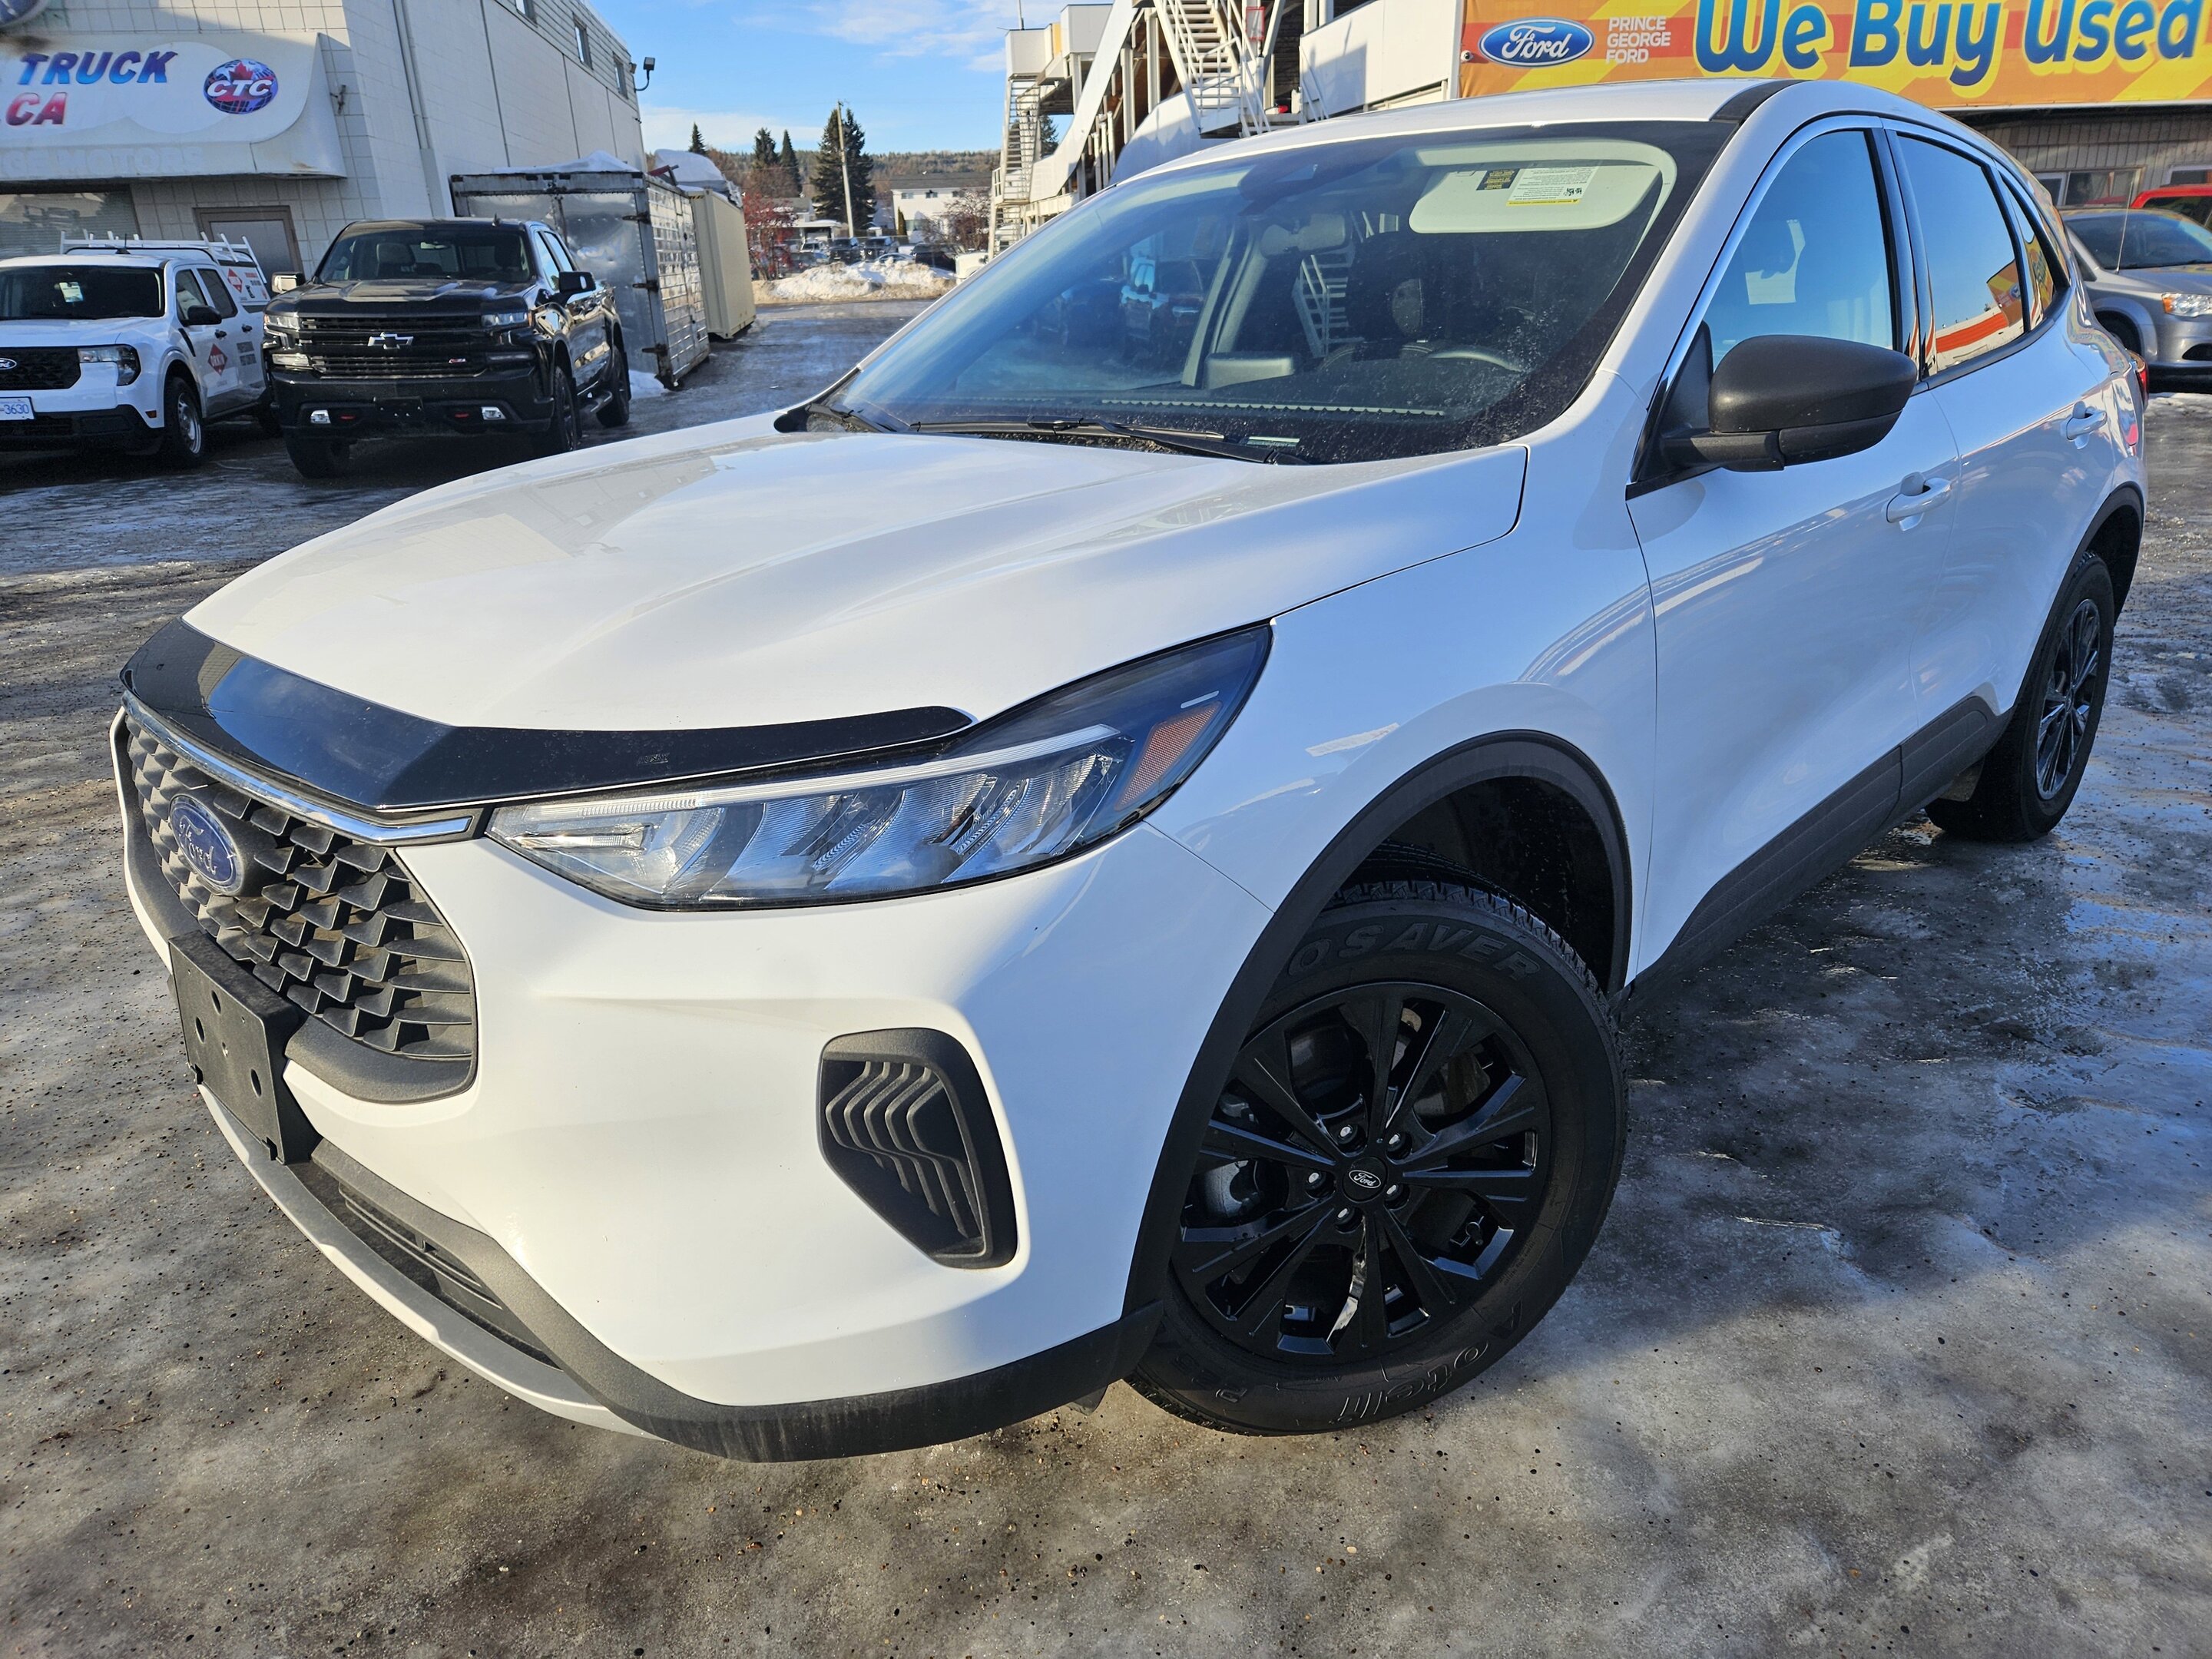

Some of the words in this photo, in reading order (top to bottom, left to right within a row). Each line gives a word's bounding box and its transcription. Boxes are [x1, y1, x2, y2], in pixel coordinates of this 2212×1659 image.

[1608, 17, 1667, 31] PRINCE
[1502, 25, 1572, 58] Ford
[1607, 32, 1671, 48] GEORGE
[1695, 0, 1826, 72] We
[1849, 0, 2001, 86] Buy
[17, 51, 178, 85] TRUCK
[1605, 48, 1649, 64] FORD
[207, 79, 273, 97] CTC
[5, 91, 68, 126] CA
[178, 814, 217, 876] Ford
[1353, 1172, 1377, 1186] Ford
